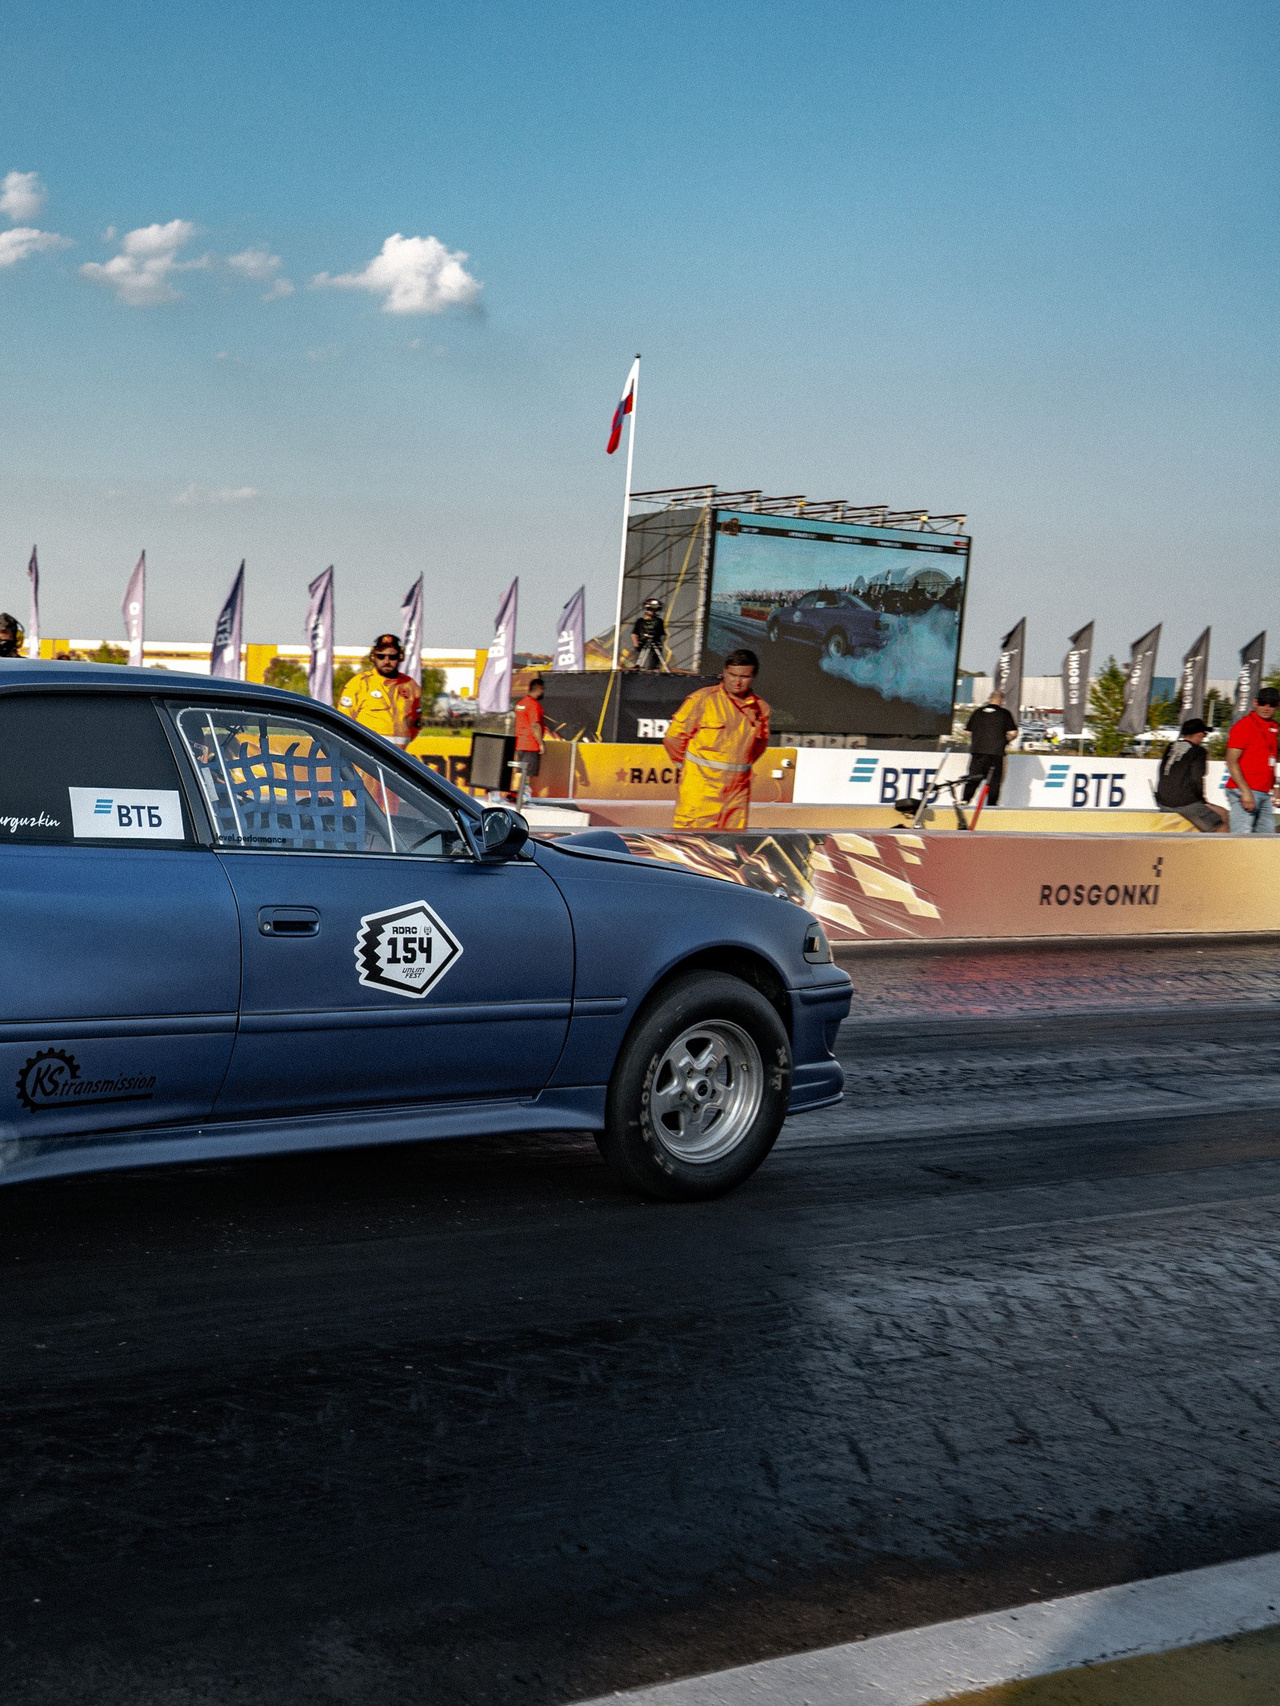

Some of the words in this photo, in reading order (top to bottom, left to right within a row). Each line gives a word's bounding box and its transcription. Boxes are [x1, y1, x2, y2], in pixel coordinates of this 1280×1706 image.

[1072, 773, 1126, 807] ВТБ
[117, 804, 163, 828] ВТБ
[1039, 884, 1160, 906] ROSGONKI
[392, 926, 418, 935] RDRC
[386, 936, 433, 964] 154
